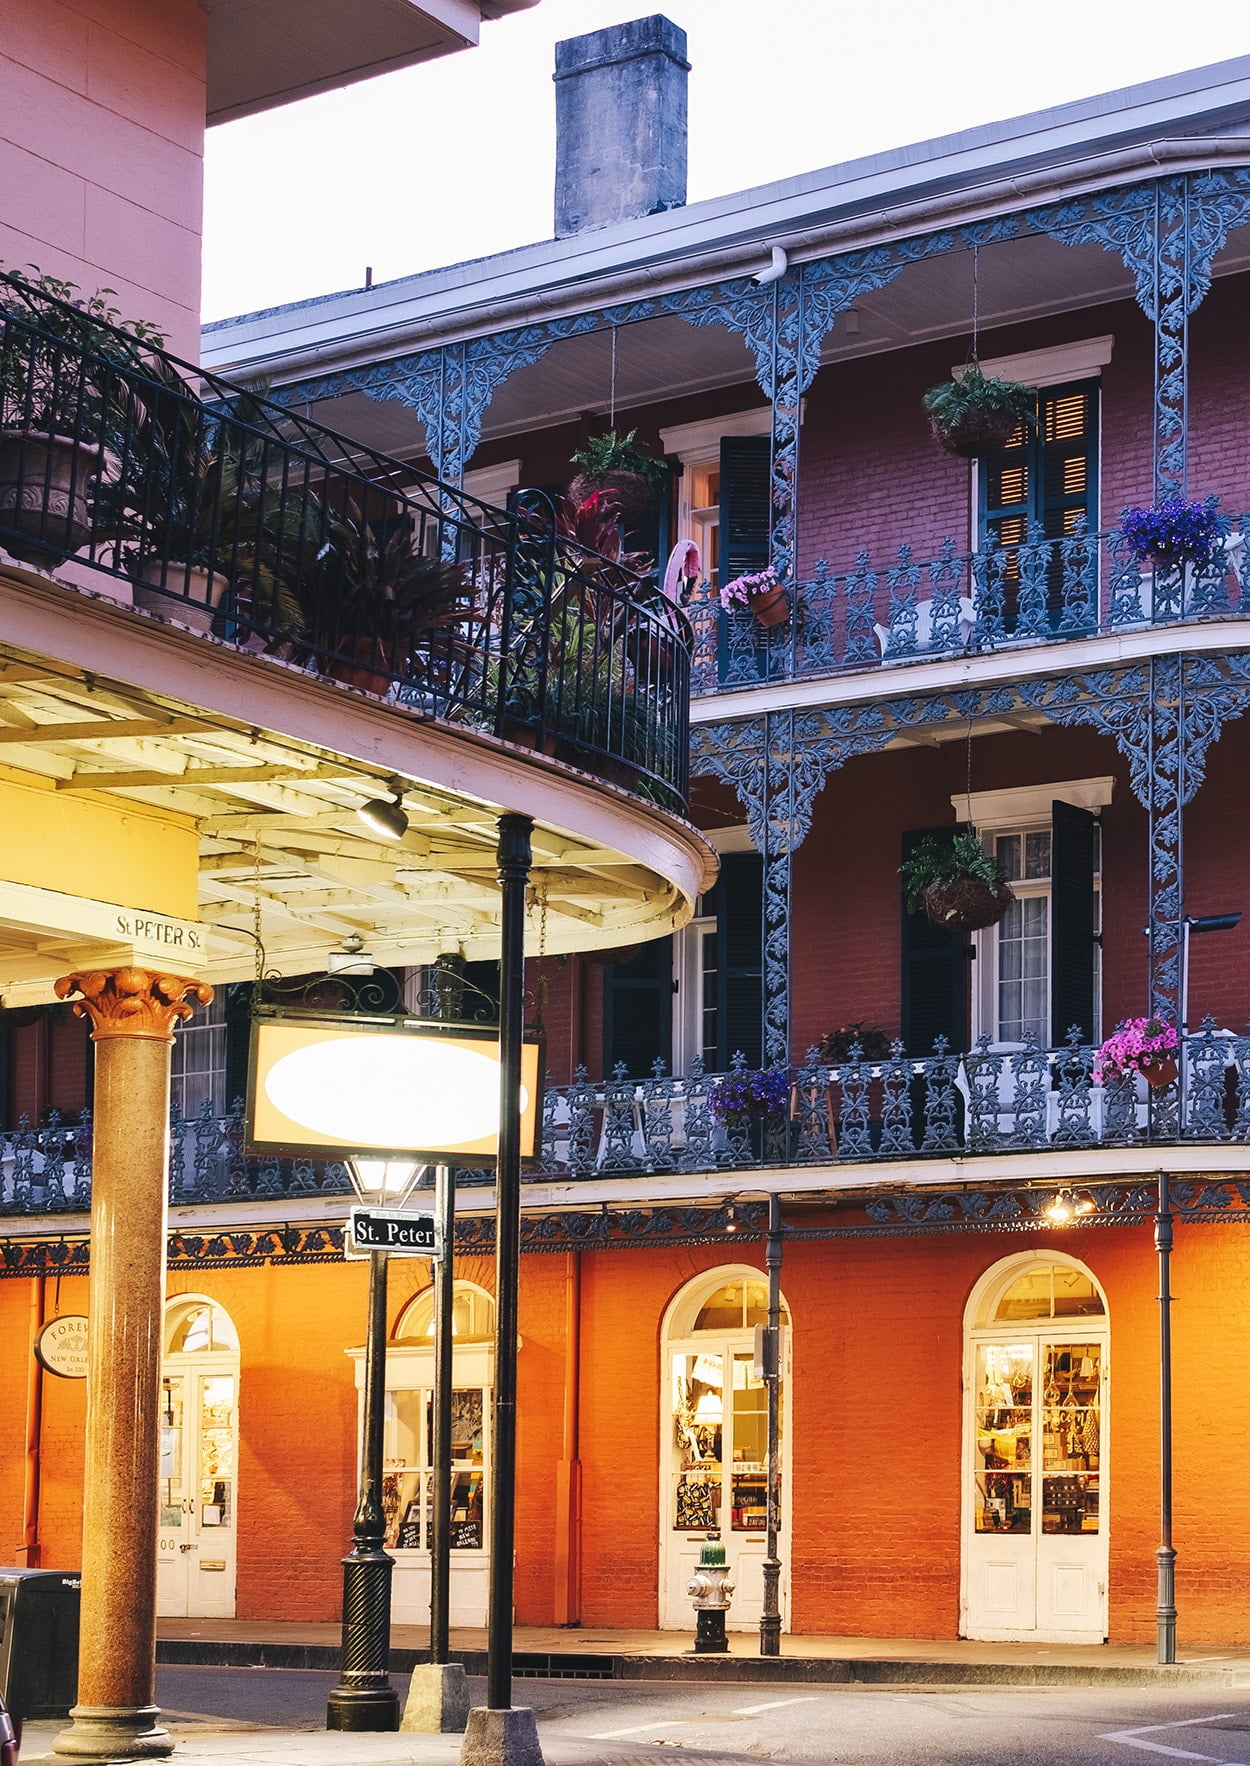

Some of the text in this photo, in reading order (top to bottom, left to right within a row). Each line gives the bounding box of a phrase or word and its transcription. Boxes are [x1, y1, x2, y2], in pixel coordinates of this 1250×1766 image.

[135, 919, 184, 945] PETER
[356, 1221, 432, 1243] St. Peter
